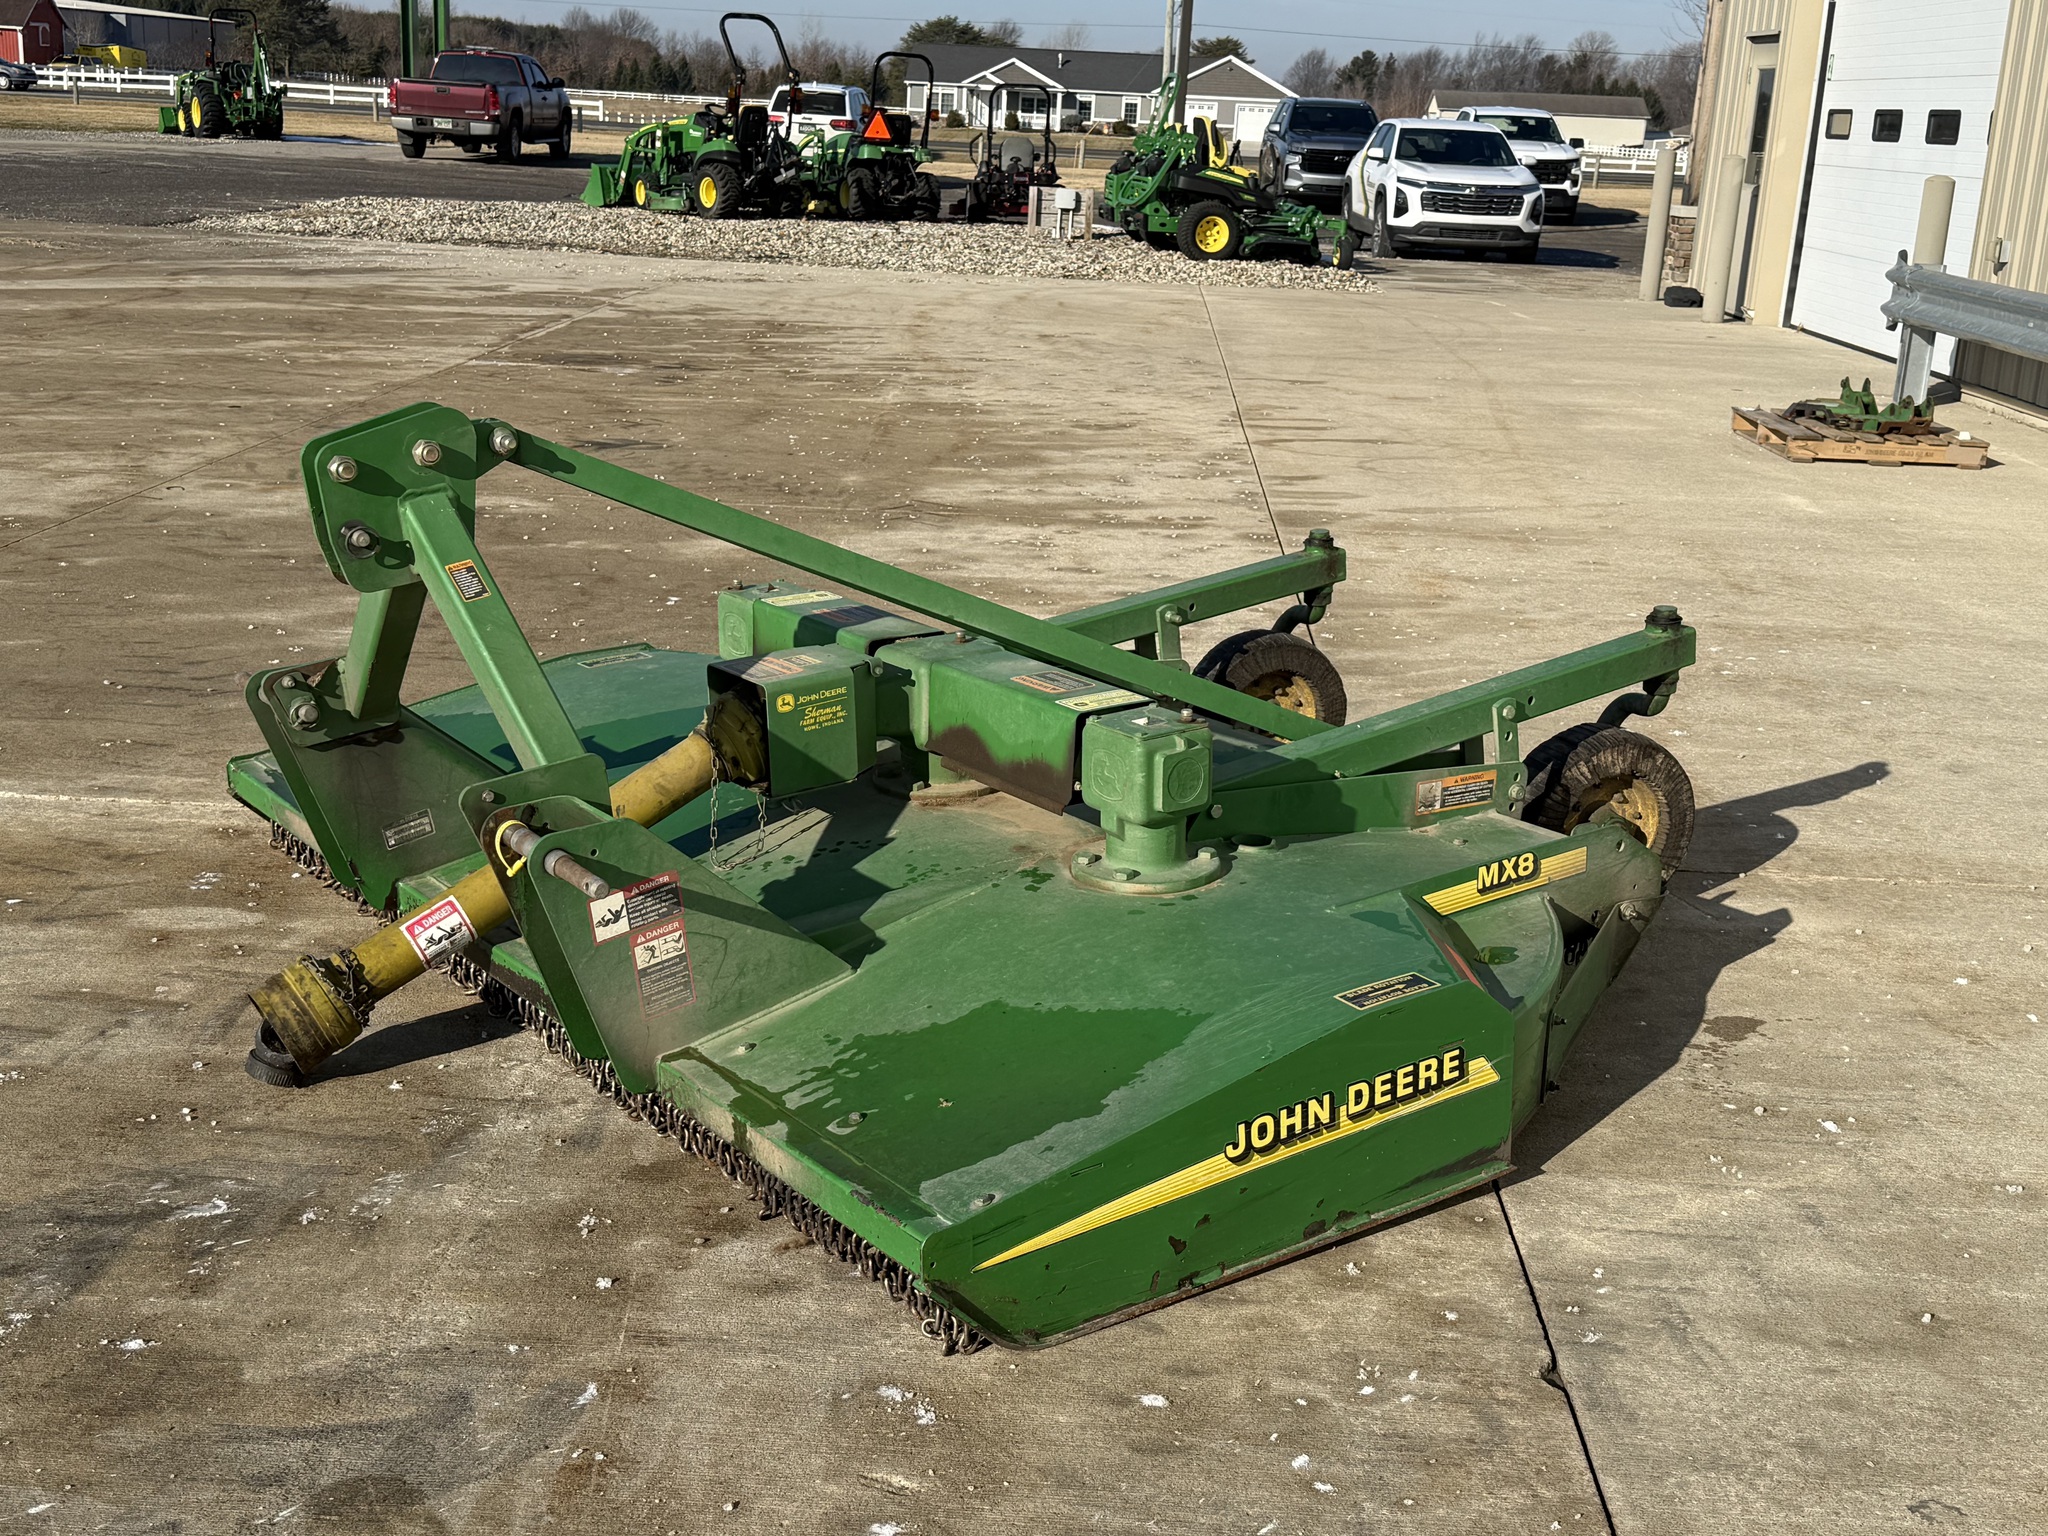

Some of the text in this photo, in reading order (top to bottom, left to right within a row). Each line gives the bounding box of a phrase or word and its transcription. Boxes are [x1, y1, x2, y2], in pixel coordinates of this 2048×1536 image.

[797, 686, 848, 704] JOHN DEERE
[804, 704, 842, 719] Sherman
[800, 718, 815, 727] FARM
[822, 718, 844, 728] INDIANA
[1477, 852, 1536, 892] MX8
[639, 875, 670, 892] DANGER
[422, 905, 454, 927] DANGER
[645, 921, 680, 939] DANGER
[1346, 975, 1413, 998] BLADE ROTATION
[1224, 1047, 1463, 1160] JOHN DEERE
